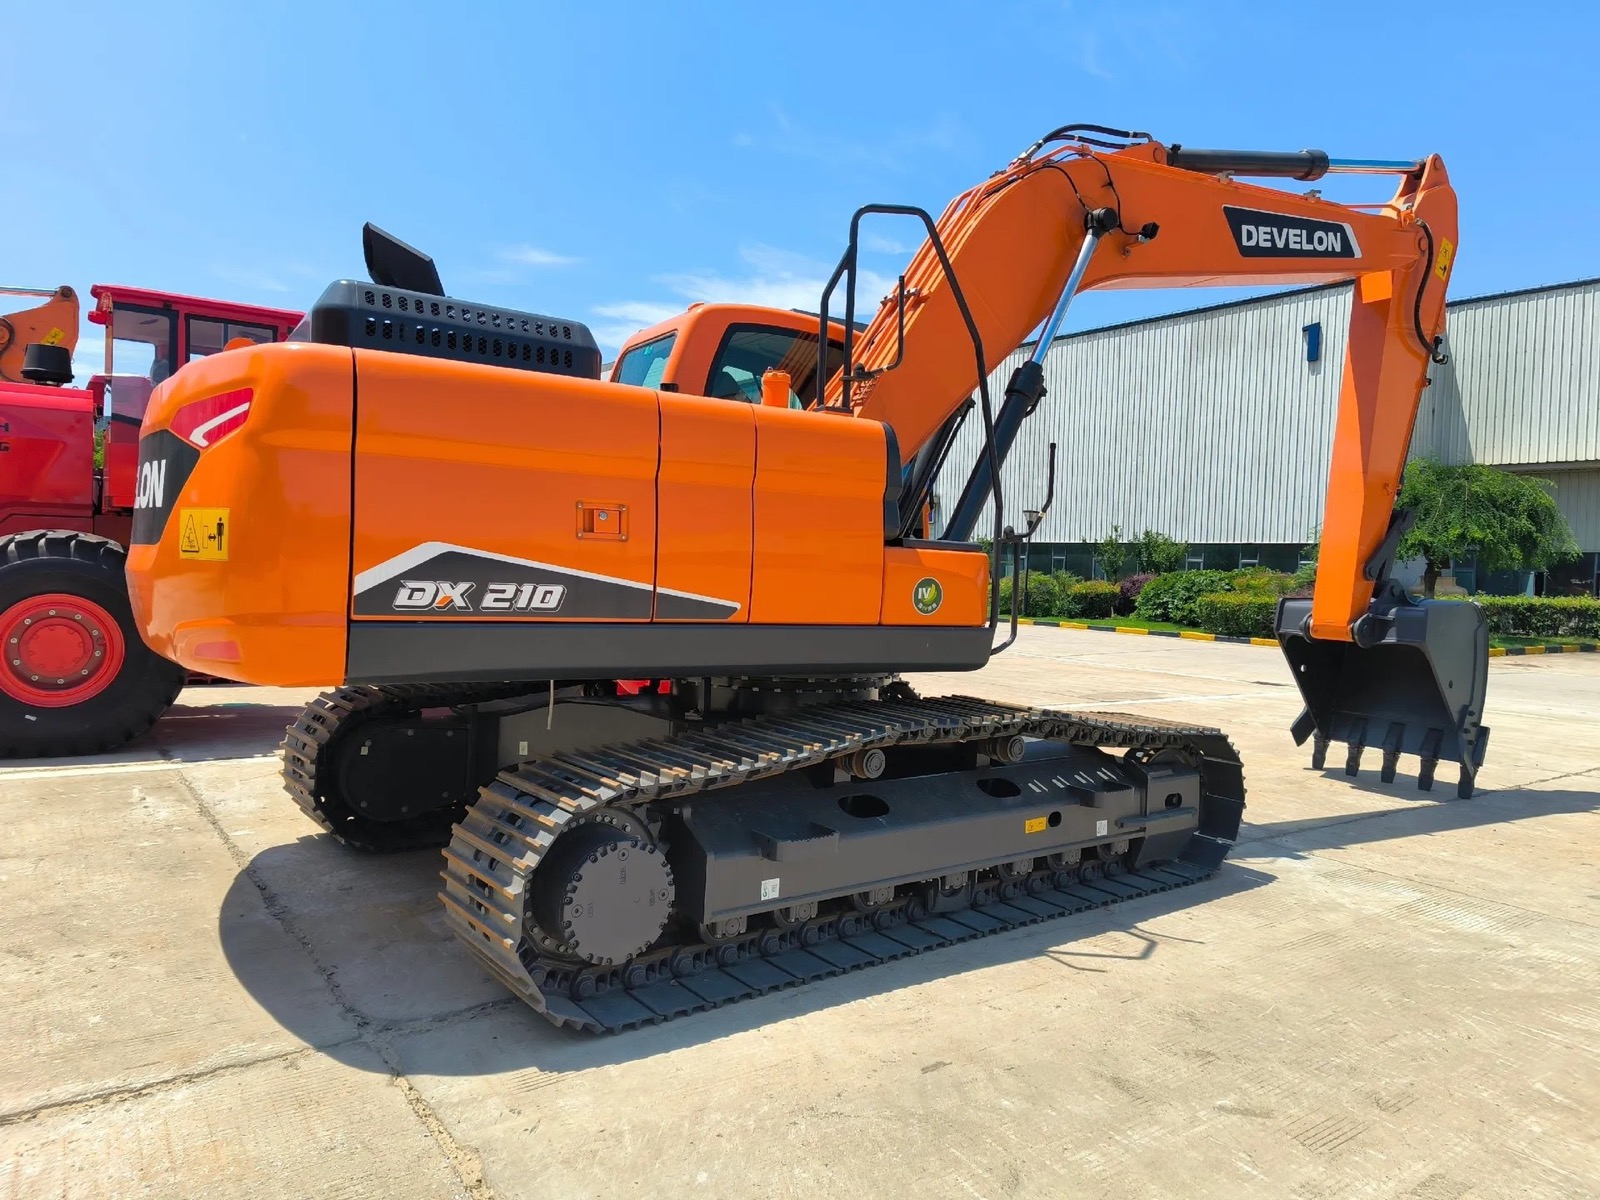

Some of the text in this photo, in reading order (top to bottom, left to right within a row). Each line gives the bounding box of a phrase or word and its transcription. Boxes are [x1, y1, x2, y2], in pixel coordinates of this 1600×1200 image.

[1242, 225, 1341, 252] DEVELON
[393, 580, 476, 611] DX
[480, 583, 567, 612] 210
